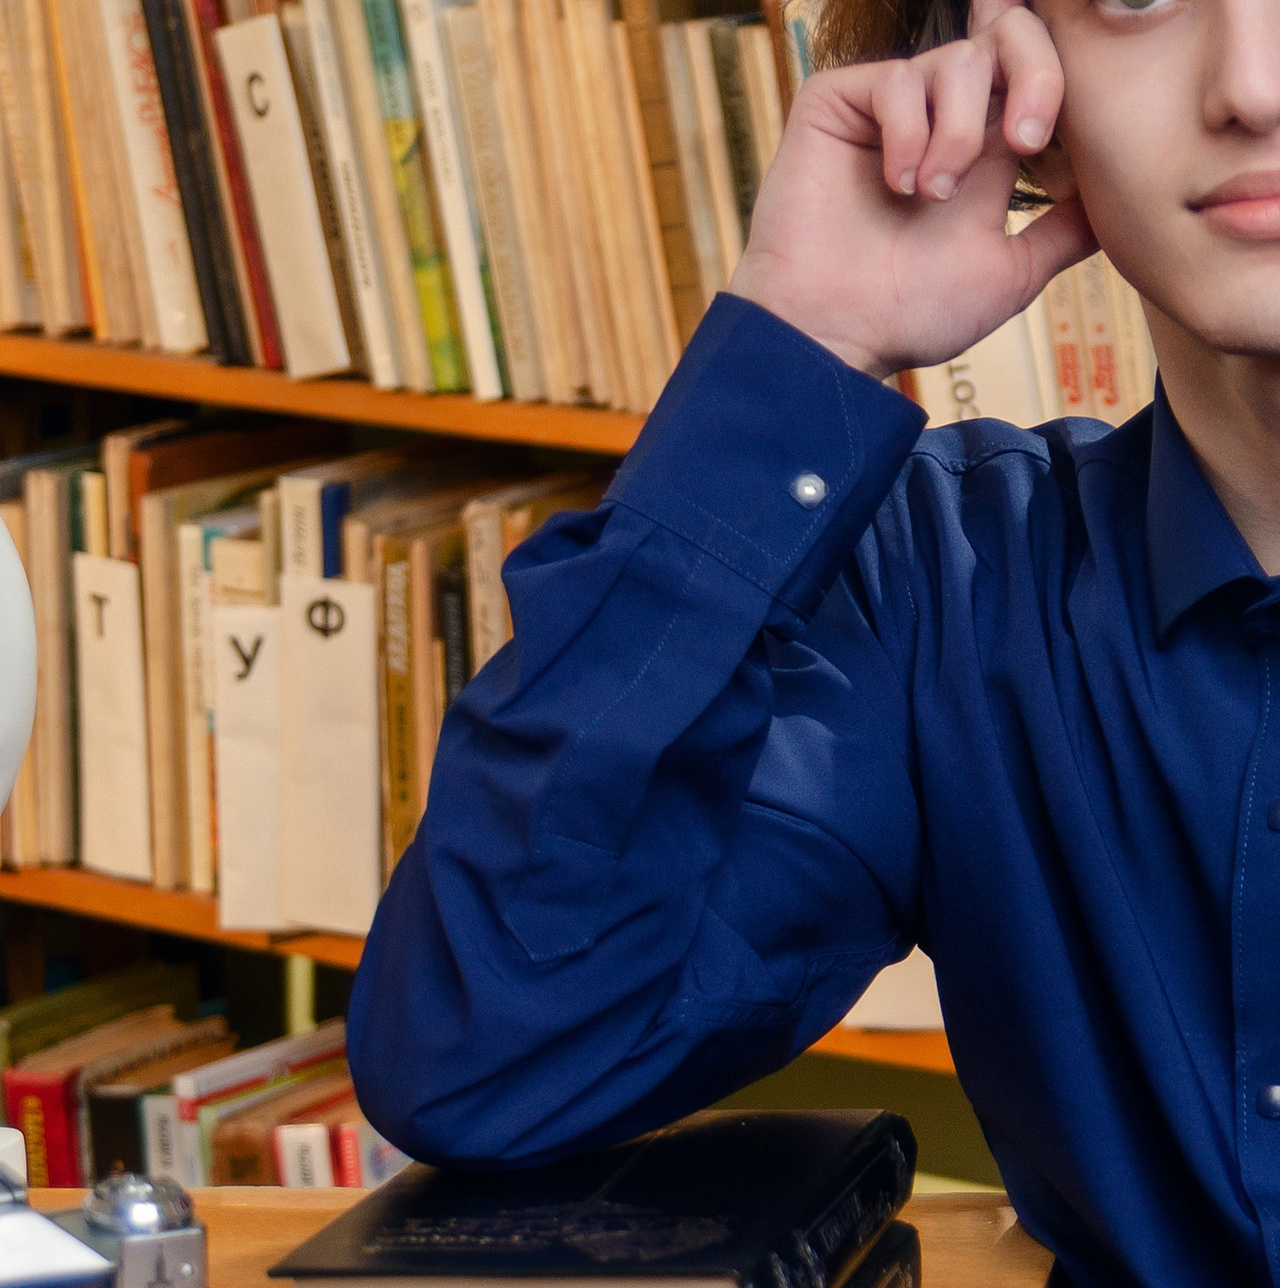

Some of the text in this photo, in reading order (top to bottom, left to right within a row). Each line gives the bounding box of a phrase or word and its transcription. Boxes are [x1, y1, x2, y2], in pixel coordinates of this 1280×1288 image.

[245, 71, 271, 120] С
[92, 594, 110, 638] Т
[306, 595, 346, 639] Ф
[230, 634, 264, 680] У
